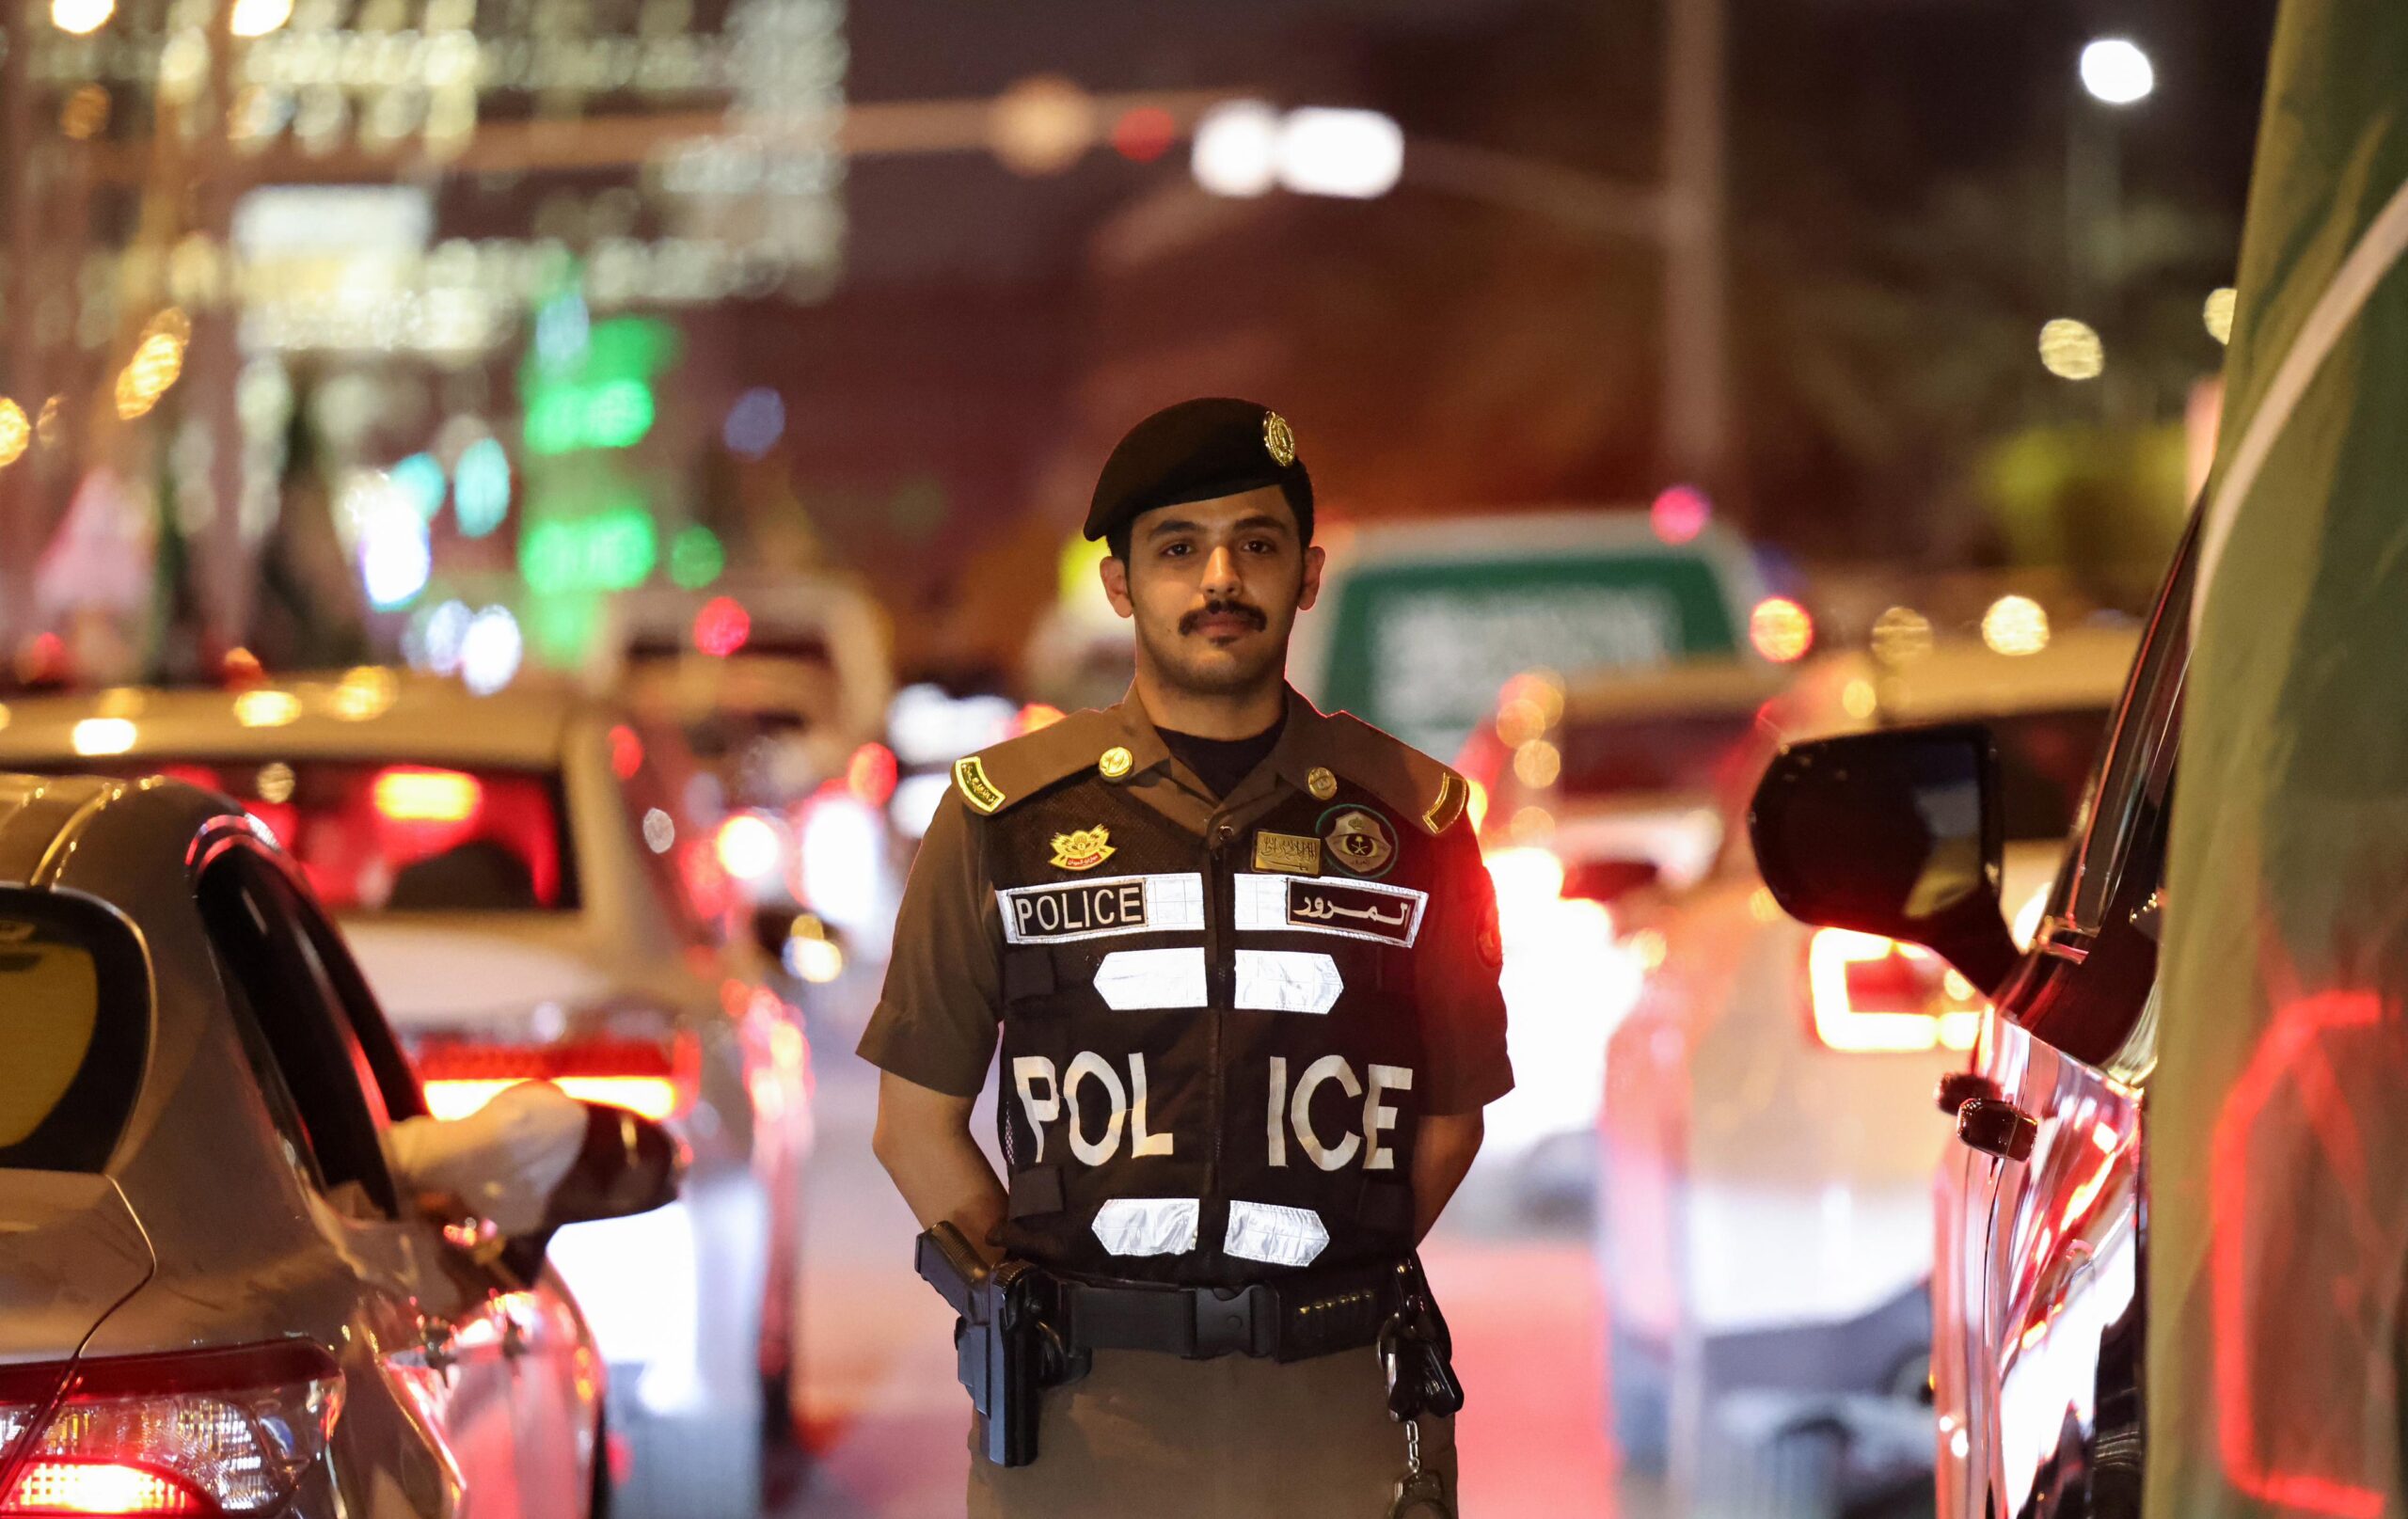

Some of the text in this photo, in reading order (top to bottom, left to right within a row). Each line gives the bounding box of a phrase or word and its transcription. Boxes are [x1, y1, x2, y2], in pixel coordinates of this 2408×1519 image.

[1015, 887, 1141, 935] POLICE
[1292, 896, 1411, 928] المرور
[1013, 1051, 1413, 1171] POL ICE
